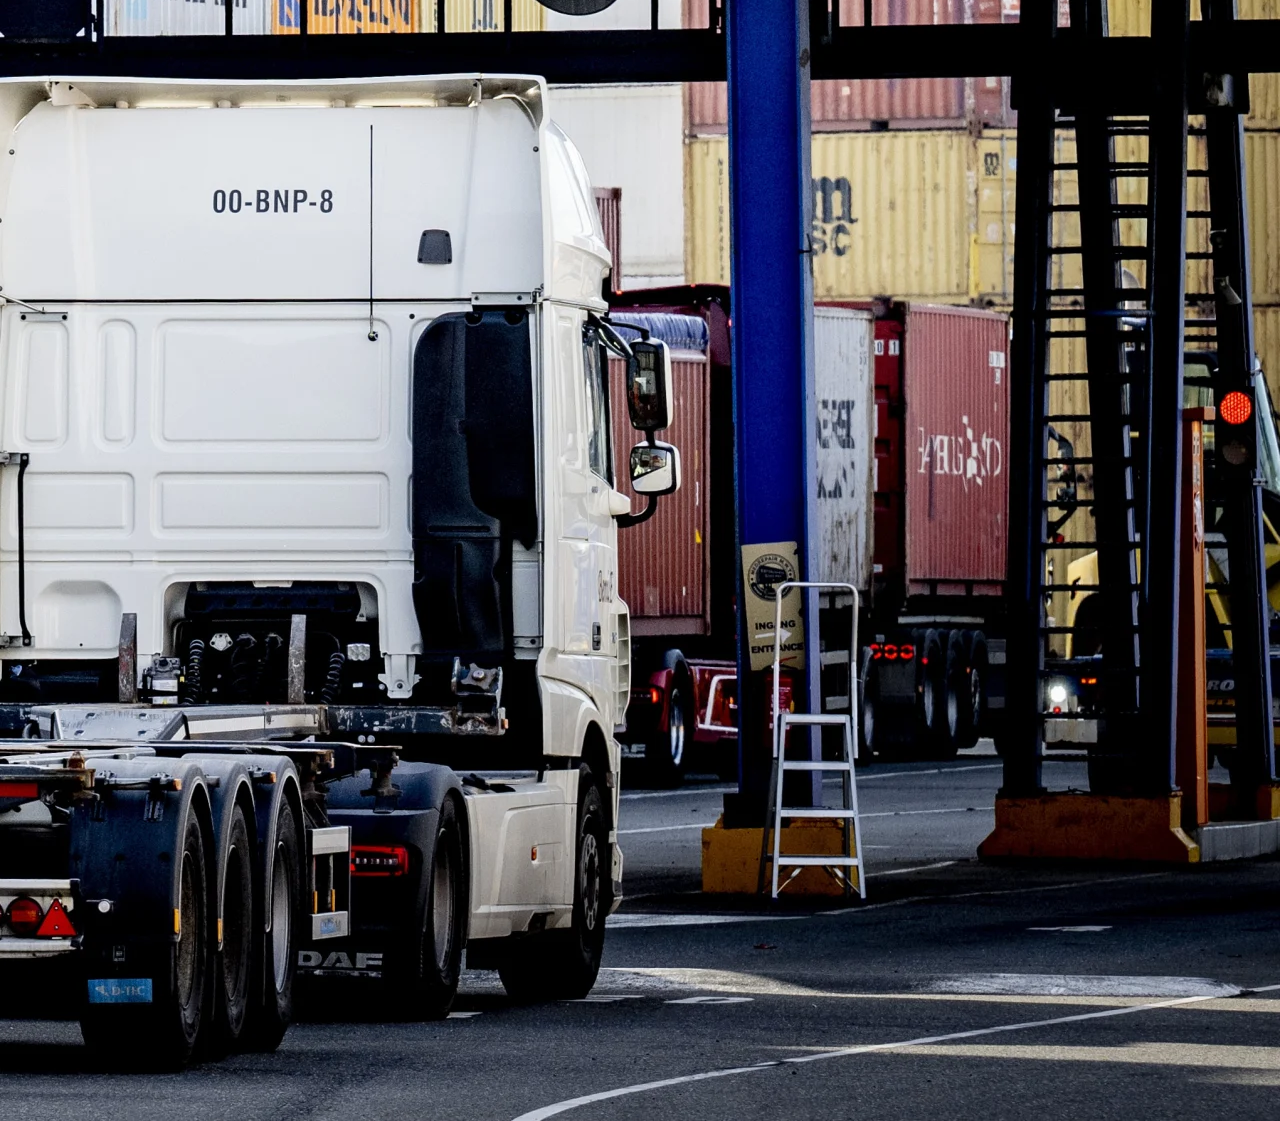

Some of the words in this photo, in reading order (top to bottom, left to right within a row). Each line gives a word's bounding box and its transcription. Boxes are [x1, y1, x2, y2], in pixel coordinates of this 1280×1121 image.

[212, 189, 334, 214] 00-BNP-8
[754, 619, 796, 631] INGNG
[297, 950, 384, 969] DAF
